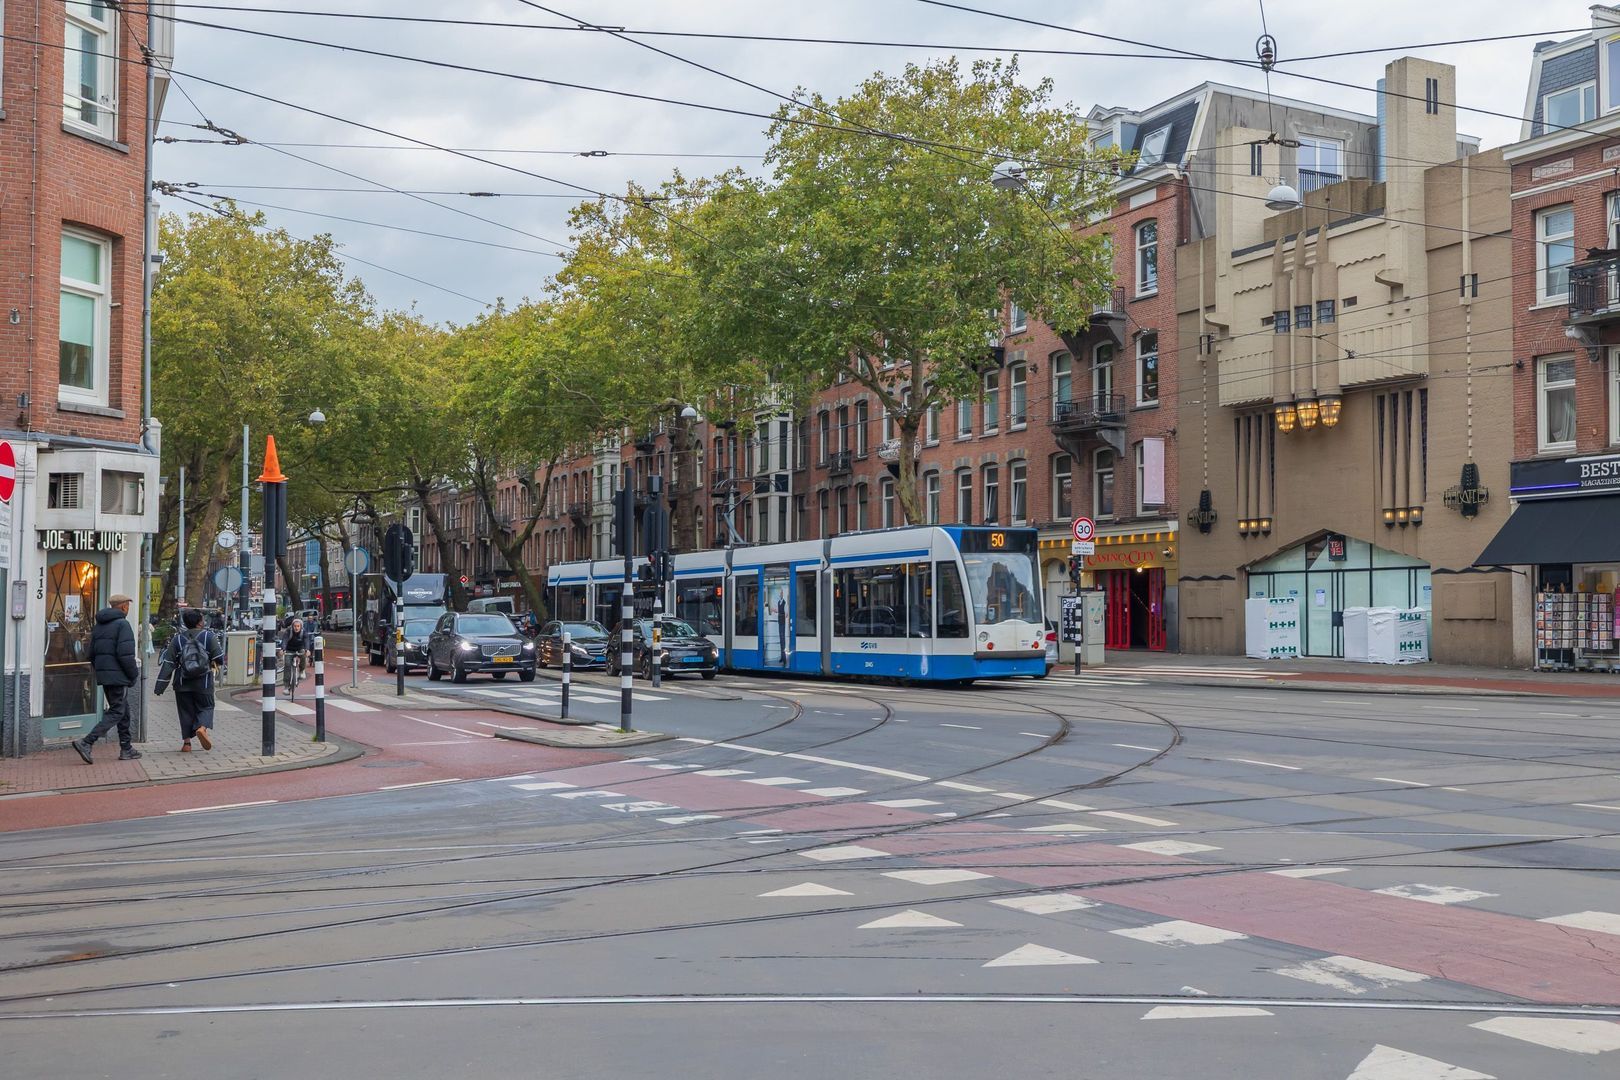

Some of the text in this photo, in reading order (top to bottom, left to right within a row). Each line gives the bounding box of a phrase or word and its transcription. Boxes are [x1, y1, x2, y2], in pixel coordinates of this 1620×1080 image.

[1580, 461, 1620, 478] BEST
[1077, 525, 1090, 534] 30
[43, 530, 65, 549] JOE
[73, 530, 95, 550] THE
[97, 531, 128, 551] JUICE
[991, 533, 1004, 547] 50
[1087, 550, 1156, 566] CASINO CITY
[36, 566, 44, 600] 113
[1270, 620, 1296, 629] H+H
[1271, 646, 1297, 654] H+H
[1399, 640, 1422, 651] H+H
